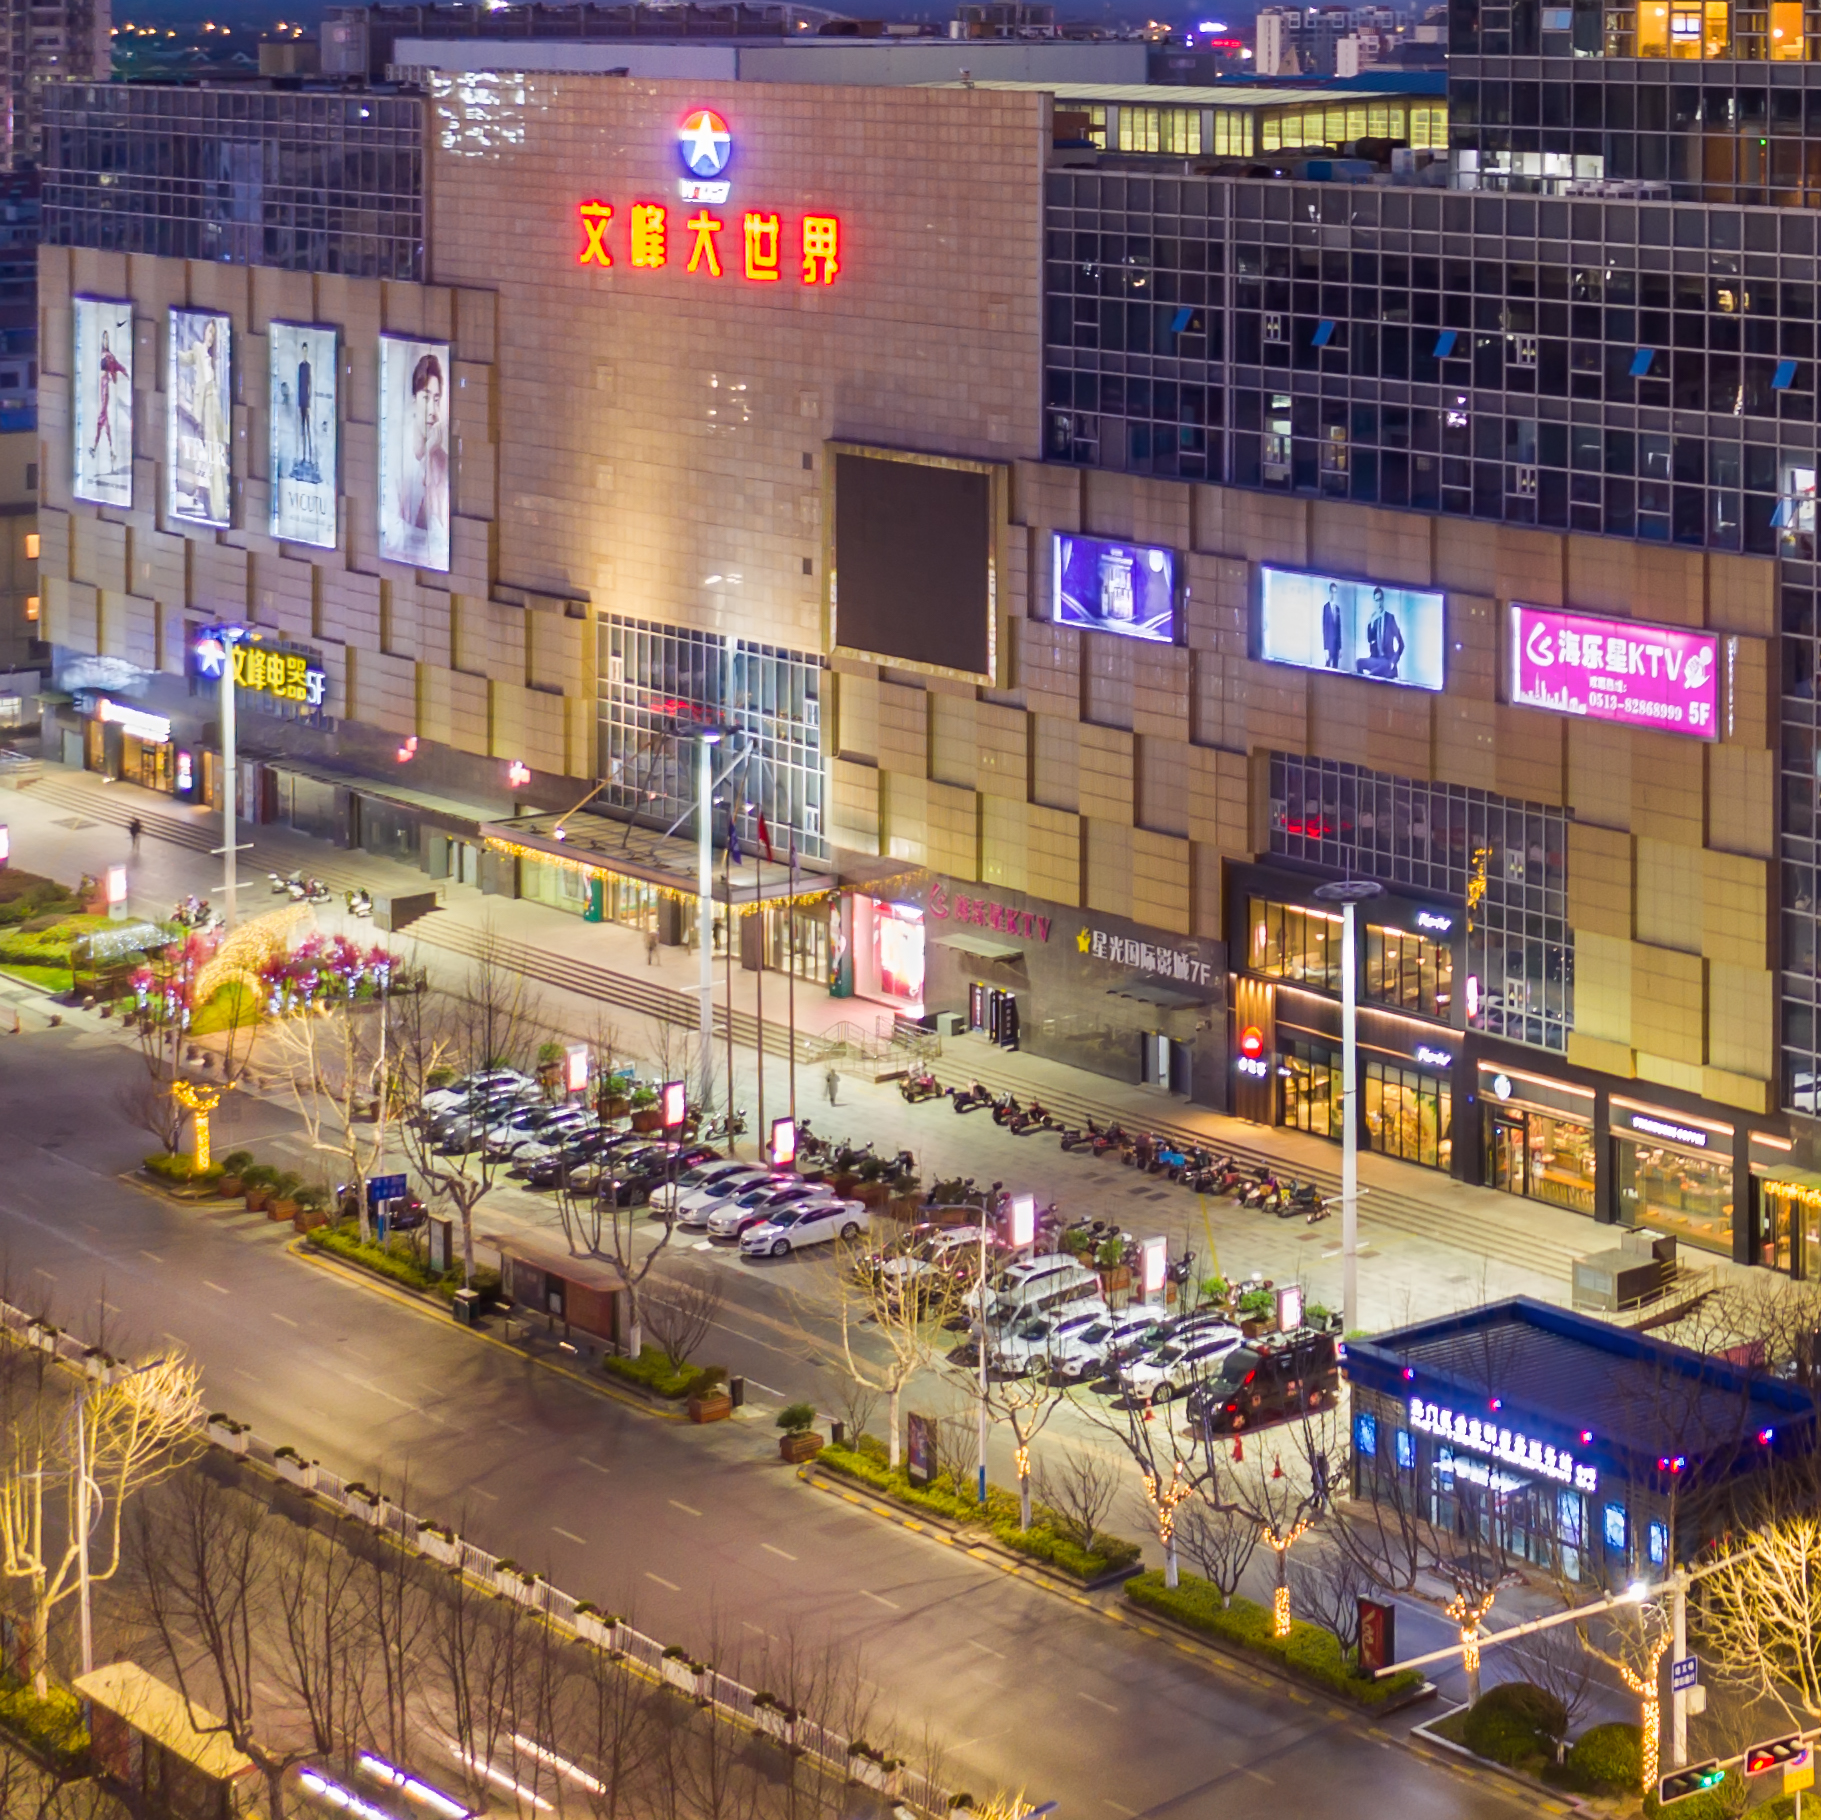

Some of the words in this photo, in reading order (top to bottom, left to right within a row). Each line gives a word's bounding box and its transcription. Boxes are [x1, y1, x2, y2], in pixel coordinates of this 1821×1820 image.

[578, 200, 839, 285] 文峰大世界
[1558, 629, 1684, 681] 海乐星KTV
[1688, 700, 1711, 726] 5F
[954, 892, 1052, 943] 海乐星KTV
[1092, 929, 1211, 986] 星光国际影城7F
